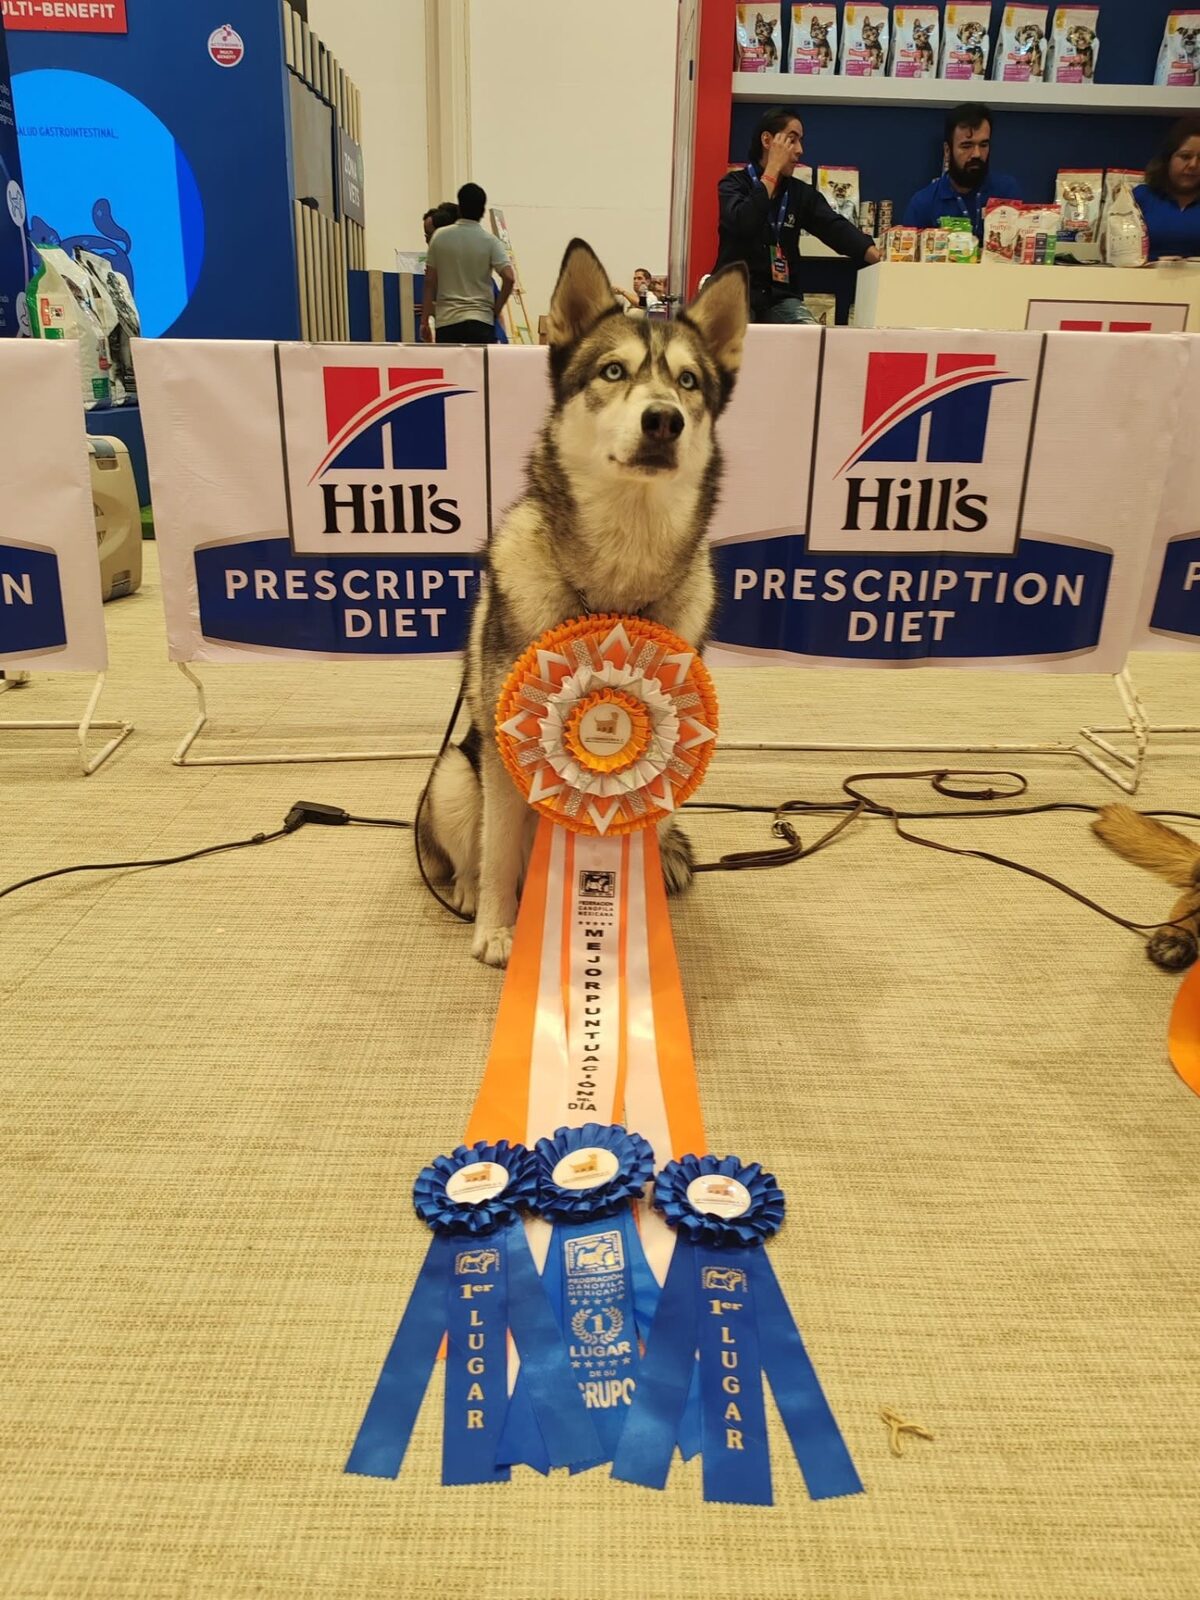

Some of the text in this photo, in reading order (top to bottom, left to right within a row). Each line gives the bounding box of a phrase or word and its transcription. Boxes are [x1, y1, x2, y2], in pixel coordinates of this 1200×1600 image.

[320, 483, 461, 535] Hill's
[842, 477, 989, 533] Hill's
[733, 568, 1085, 606] PRESCRIPTION
[344, 608, 447, 638] DIET
[847, 610, 956, 643] DIET
[460, 1283, 495, 1299] 1er
[567, 1286, 625, 1297] MEXICANA
[708, 1299, 744, 1315] 1er
[591, 1313, 607, 1334] 1
[569, 1340, 632, 1358] LUGAR
[468, 1310, 485, 1429] LUGAR
[578, 1377, 636, 1409] RUPO
[721, 1326, 745, 1450] LUGAR
